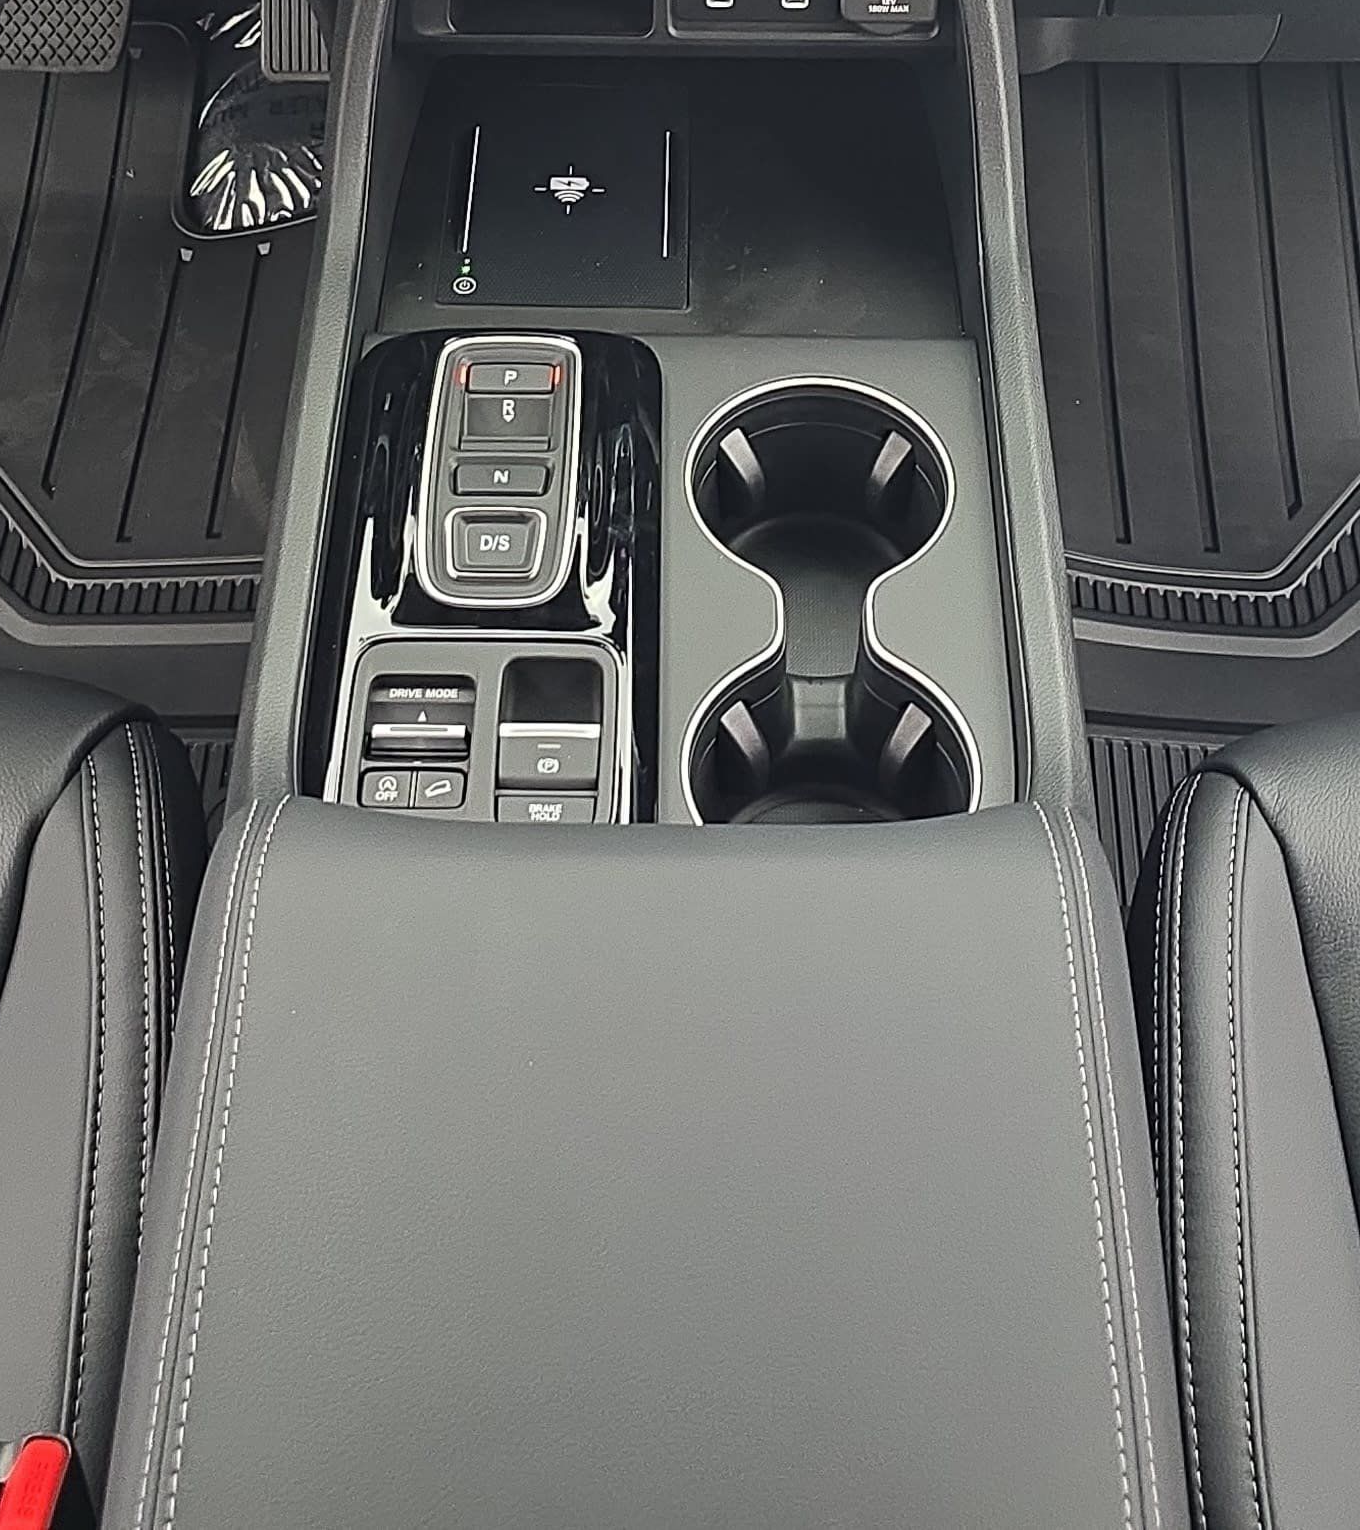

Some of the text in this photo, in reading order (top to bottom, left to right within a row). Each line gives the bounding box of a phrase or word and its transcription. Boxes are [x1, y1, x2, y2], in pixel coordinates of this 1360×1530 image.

[504, 371, 518, 384] P
[502, 399, 514, 414] R
[493, 471, 509, 483] N
[480, 535, 510, 551] D/S
[390, 688, 458, 699] DRIVE MODE
[376, 792, 397, 802] OFF
[529, 804, 562, 813] BRAKE
[531, 812, 561, 821] HOLD
